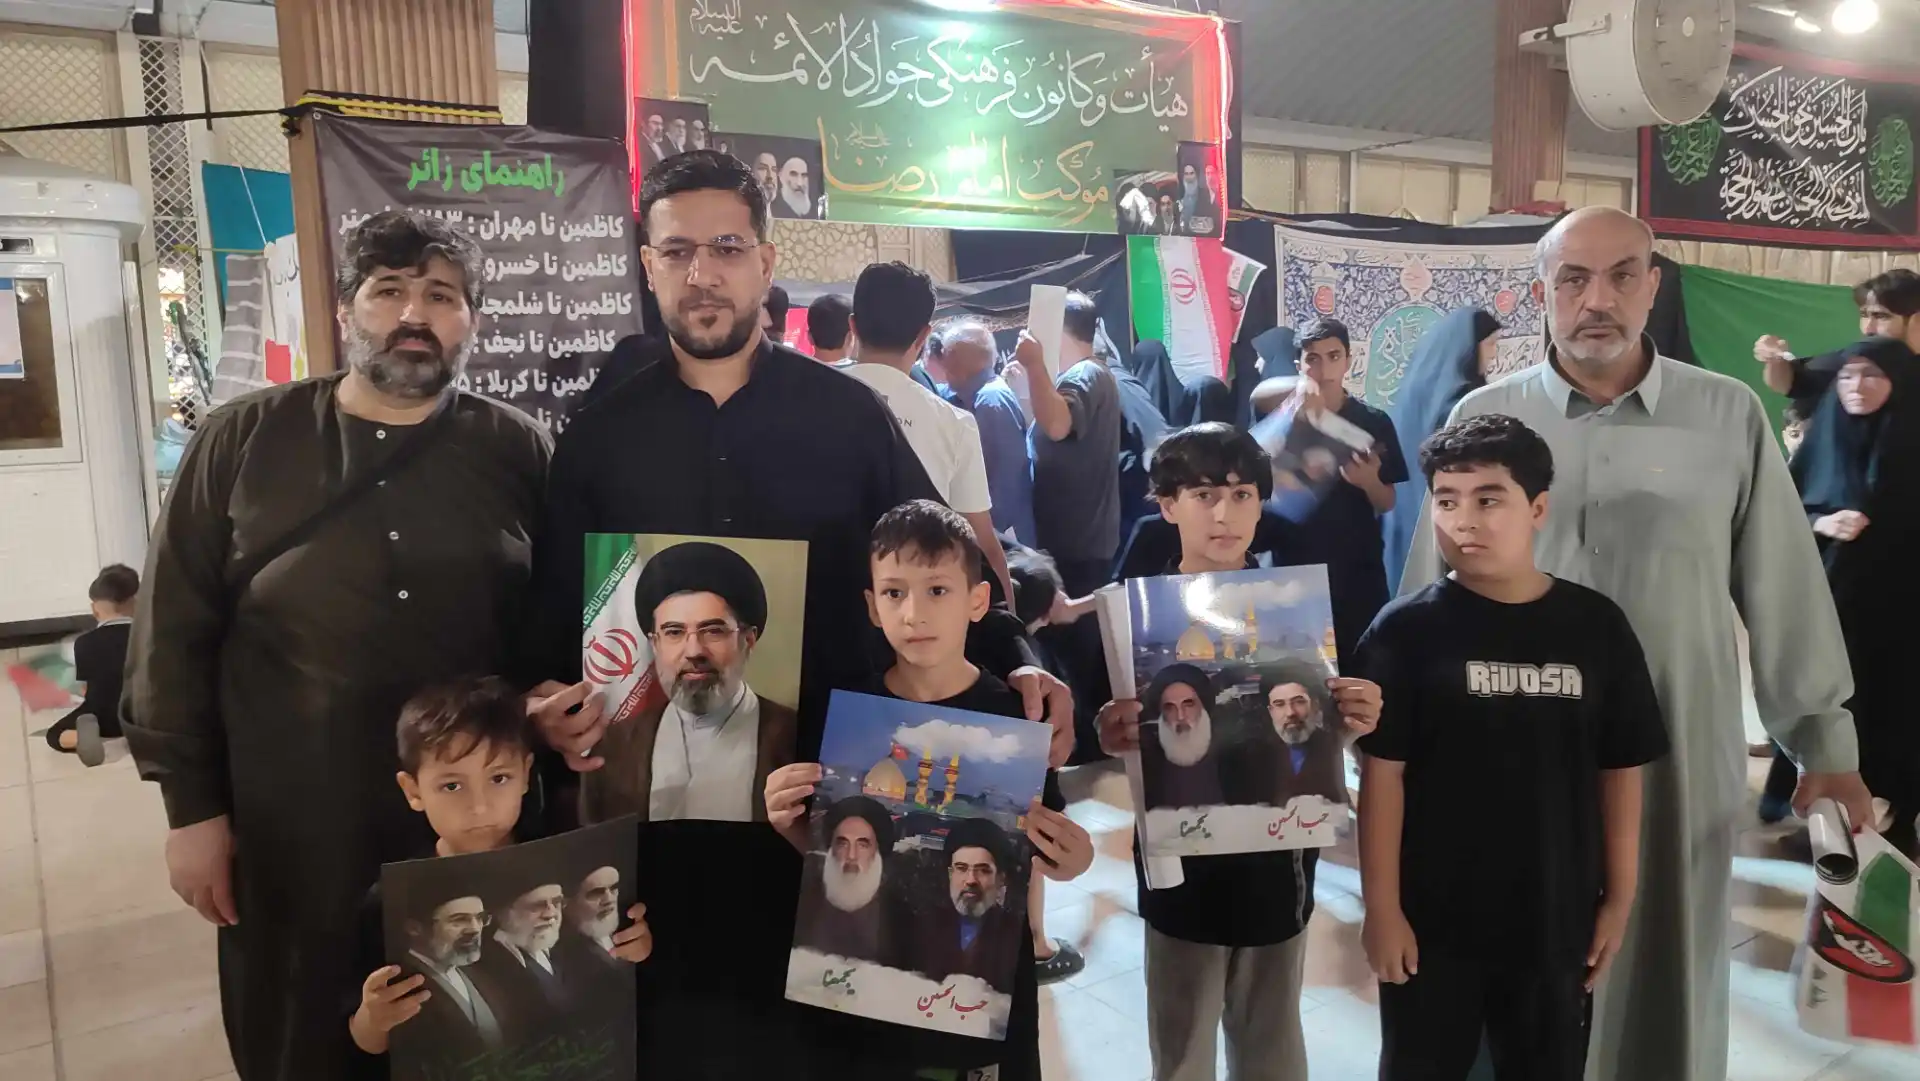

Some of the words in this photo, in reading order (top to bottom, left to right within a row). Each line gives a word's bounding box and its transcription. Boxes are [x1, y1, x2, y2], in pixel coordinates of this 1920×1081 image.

[407, 147, 454, 192] زائر
[461, 151, 566, 196] راهنمای
[479, 210, 536, 241] مهران
[541, 212, 555, 236] تا
[559, 213, 624, 242] کاظمین
[482, 254, 540, 281] خسرو
[543, 252, 558, 275] تا
[562, 253, 628, 281] کاظمین
[547, 291, 562, 315] تا
[566, 292, 632, 321] کاظمین
[484, 329, 525, 358] نجف
[529, 330, 544, 353] تا
[548, 329, 616, 359] کاظمین
[487, 369, 529, 399] کربلا
[534, 369, 548, 392] تا
[1301, 811, 1330, 835] حب
[954, 1000, 988, 1020] حب
